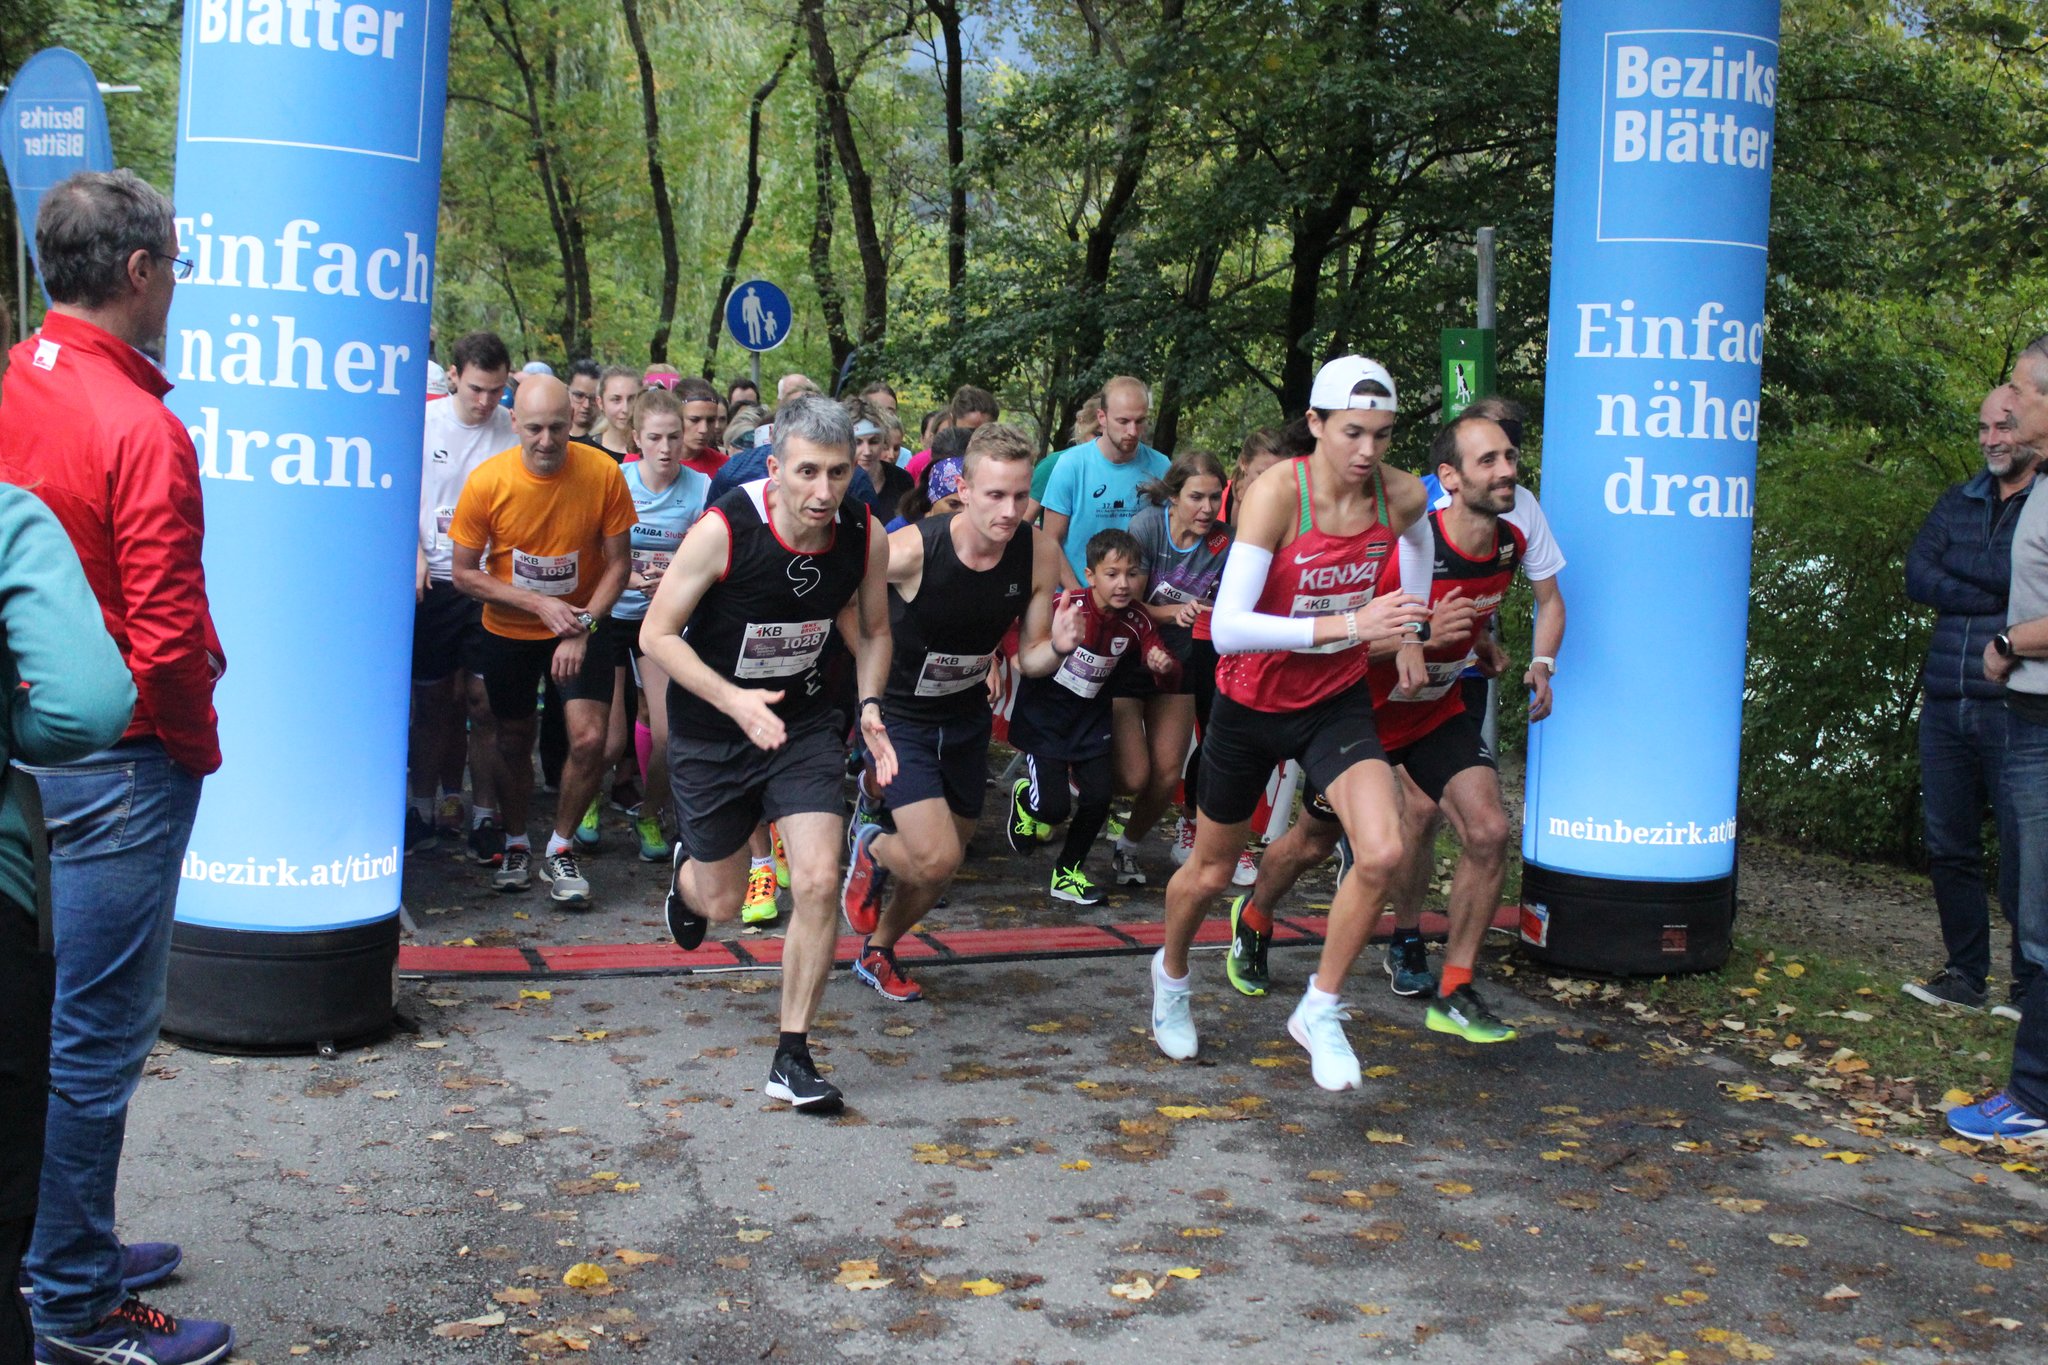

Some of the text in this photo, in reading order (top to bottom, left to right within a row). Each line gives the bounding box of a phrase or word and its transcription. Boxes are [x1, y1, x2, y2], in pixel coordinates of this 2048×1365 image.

[1616, 46, 1775, 108] Bezirks
[1613, 109, 1770, 169] Blätter
[173, 212, 429, 304] Einfach
[178, 313, 410, 395] näher
[1574, 299, 1765, 365] Einfac
[187, 406, 392, 489] dran.
[633, 526, 662, 537] RAIBA
[541, 564, 573, 576] 1092
[1298, 560, 1379, 590] KENYA
[782, 633, 821, 650] 1028
